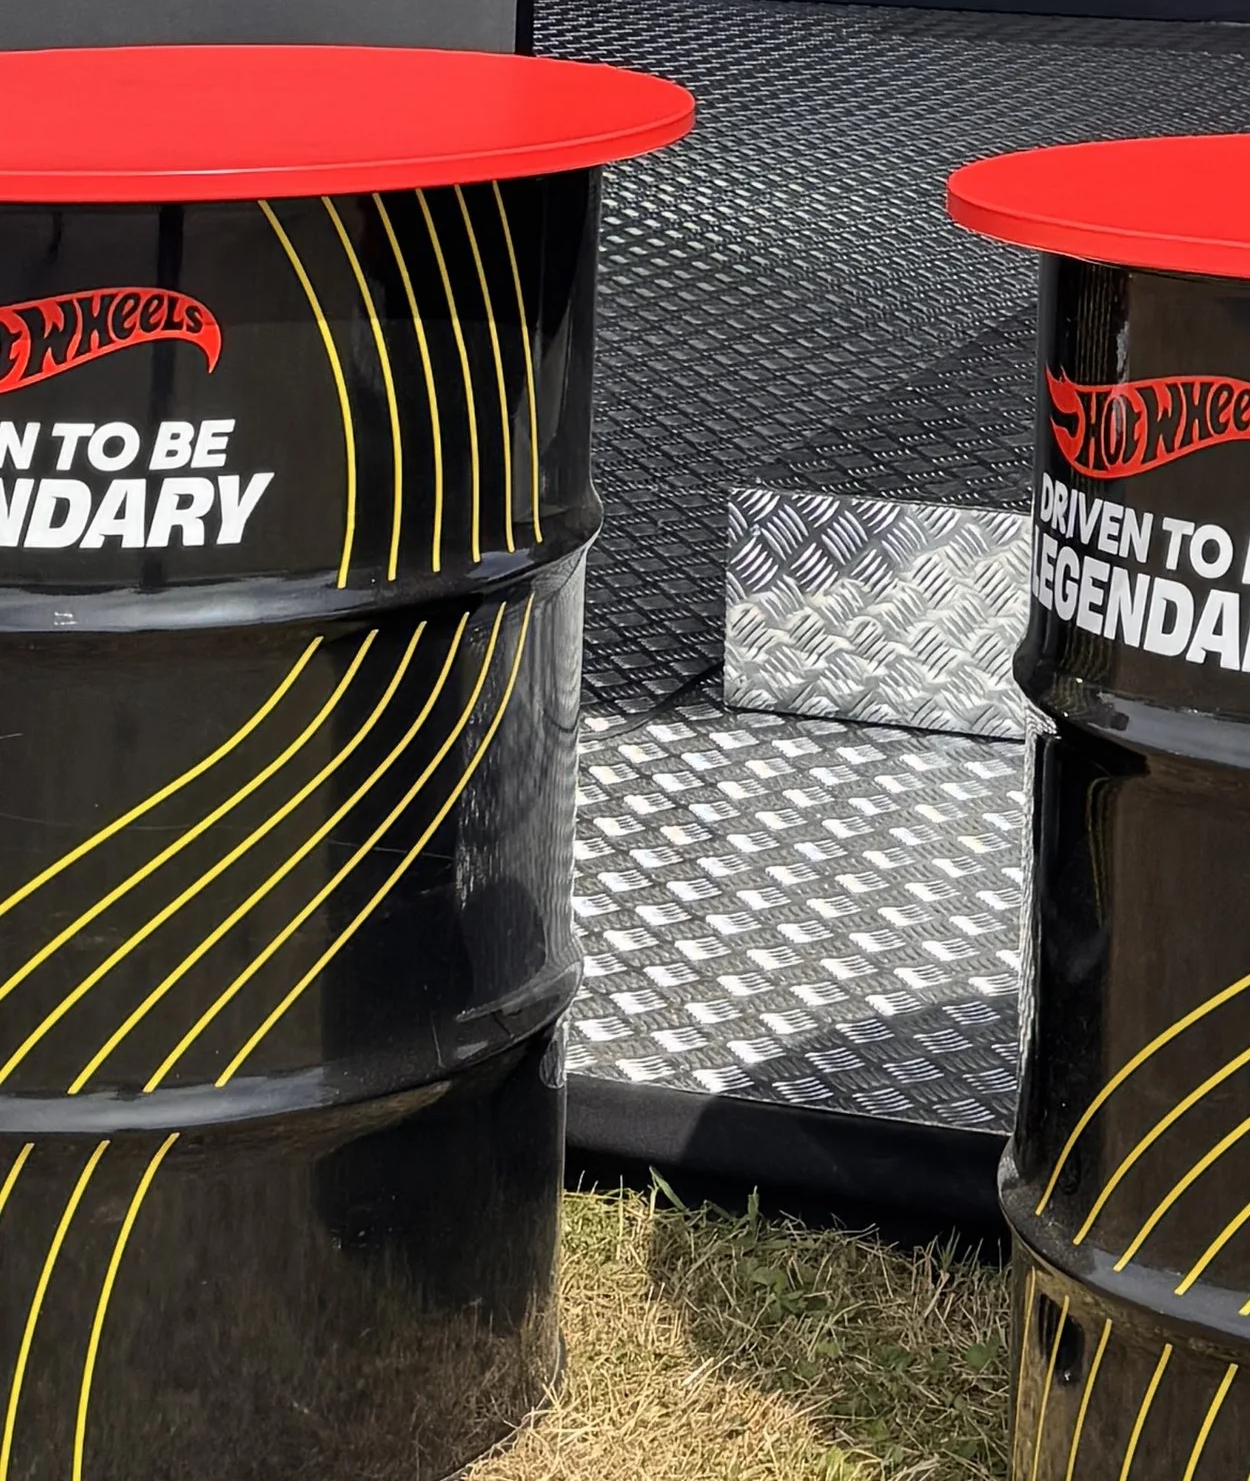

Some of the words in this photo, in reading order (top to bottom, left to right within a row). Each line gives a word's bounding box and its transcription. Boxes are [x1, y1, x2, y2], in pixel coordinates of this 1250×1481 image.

[52, 421, 140, 471] TO
[149, 419, 235, 470] BE
[1041, 472, 1153, 563] DRIVEN
[1163, 517, 1233, 579] TO
